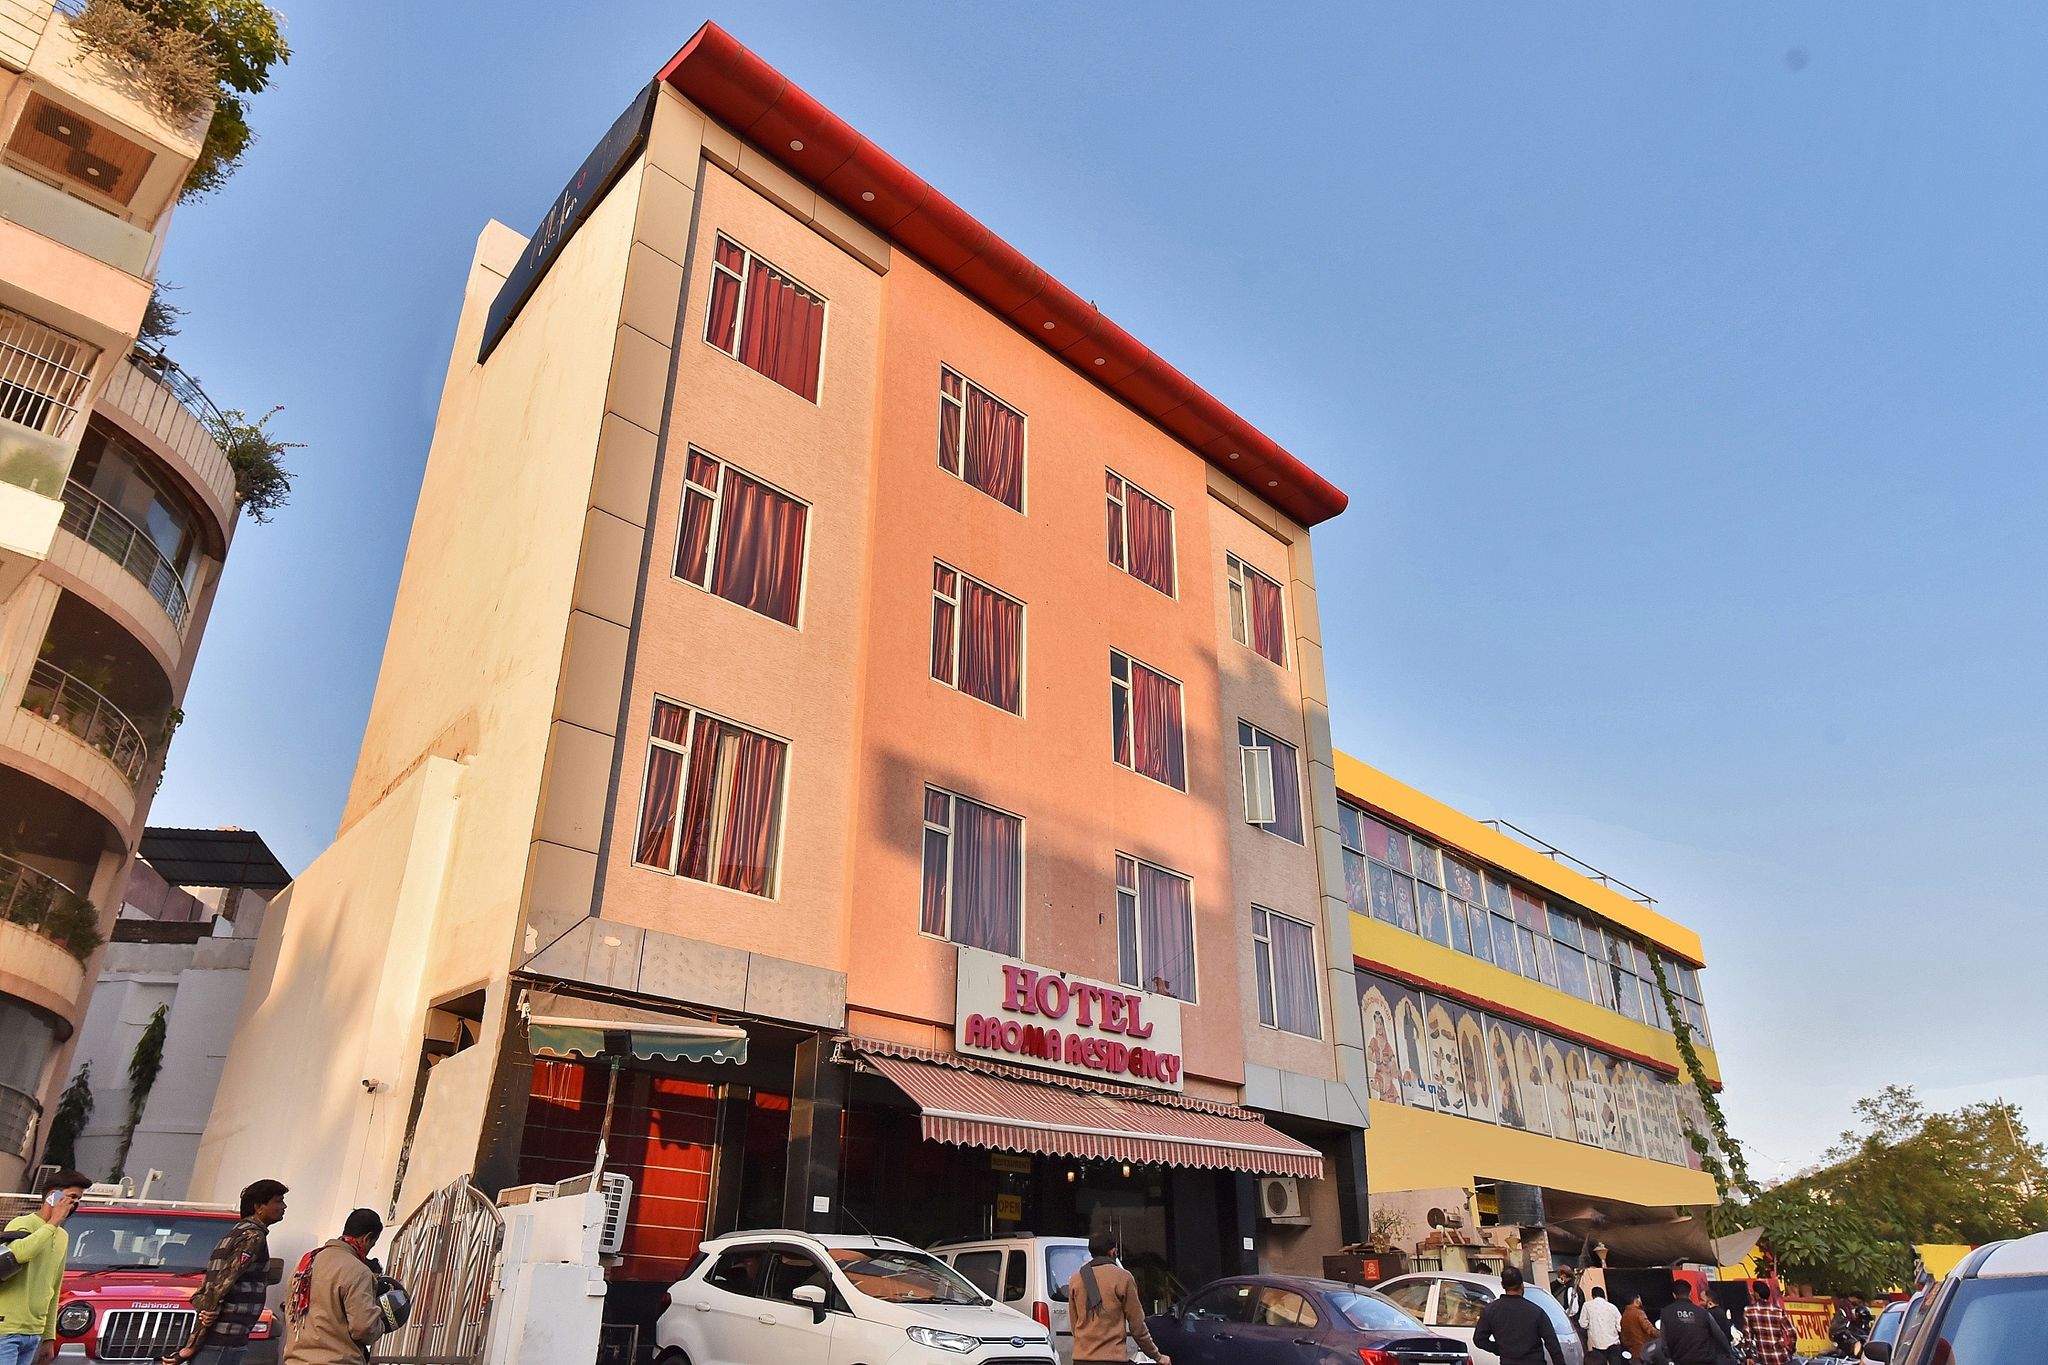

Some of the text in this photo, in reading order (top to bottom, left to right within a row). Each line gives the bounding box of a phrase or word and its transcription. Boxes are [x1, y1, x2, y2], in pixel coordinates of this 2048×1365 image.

[1002, 964, 1153, 1039] HOTEL
[965, 1013, 1181, 1084] AROMA RESIDENCY
[998, 1199, 1021, 1214] OPEN
